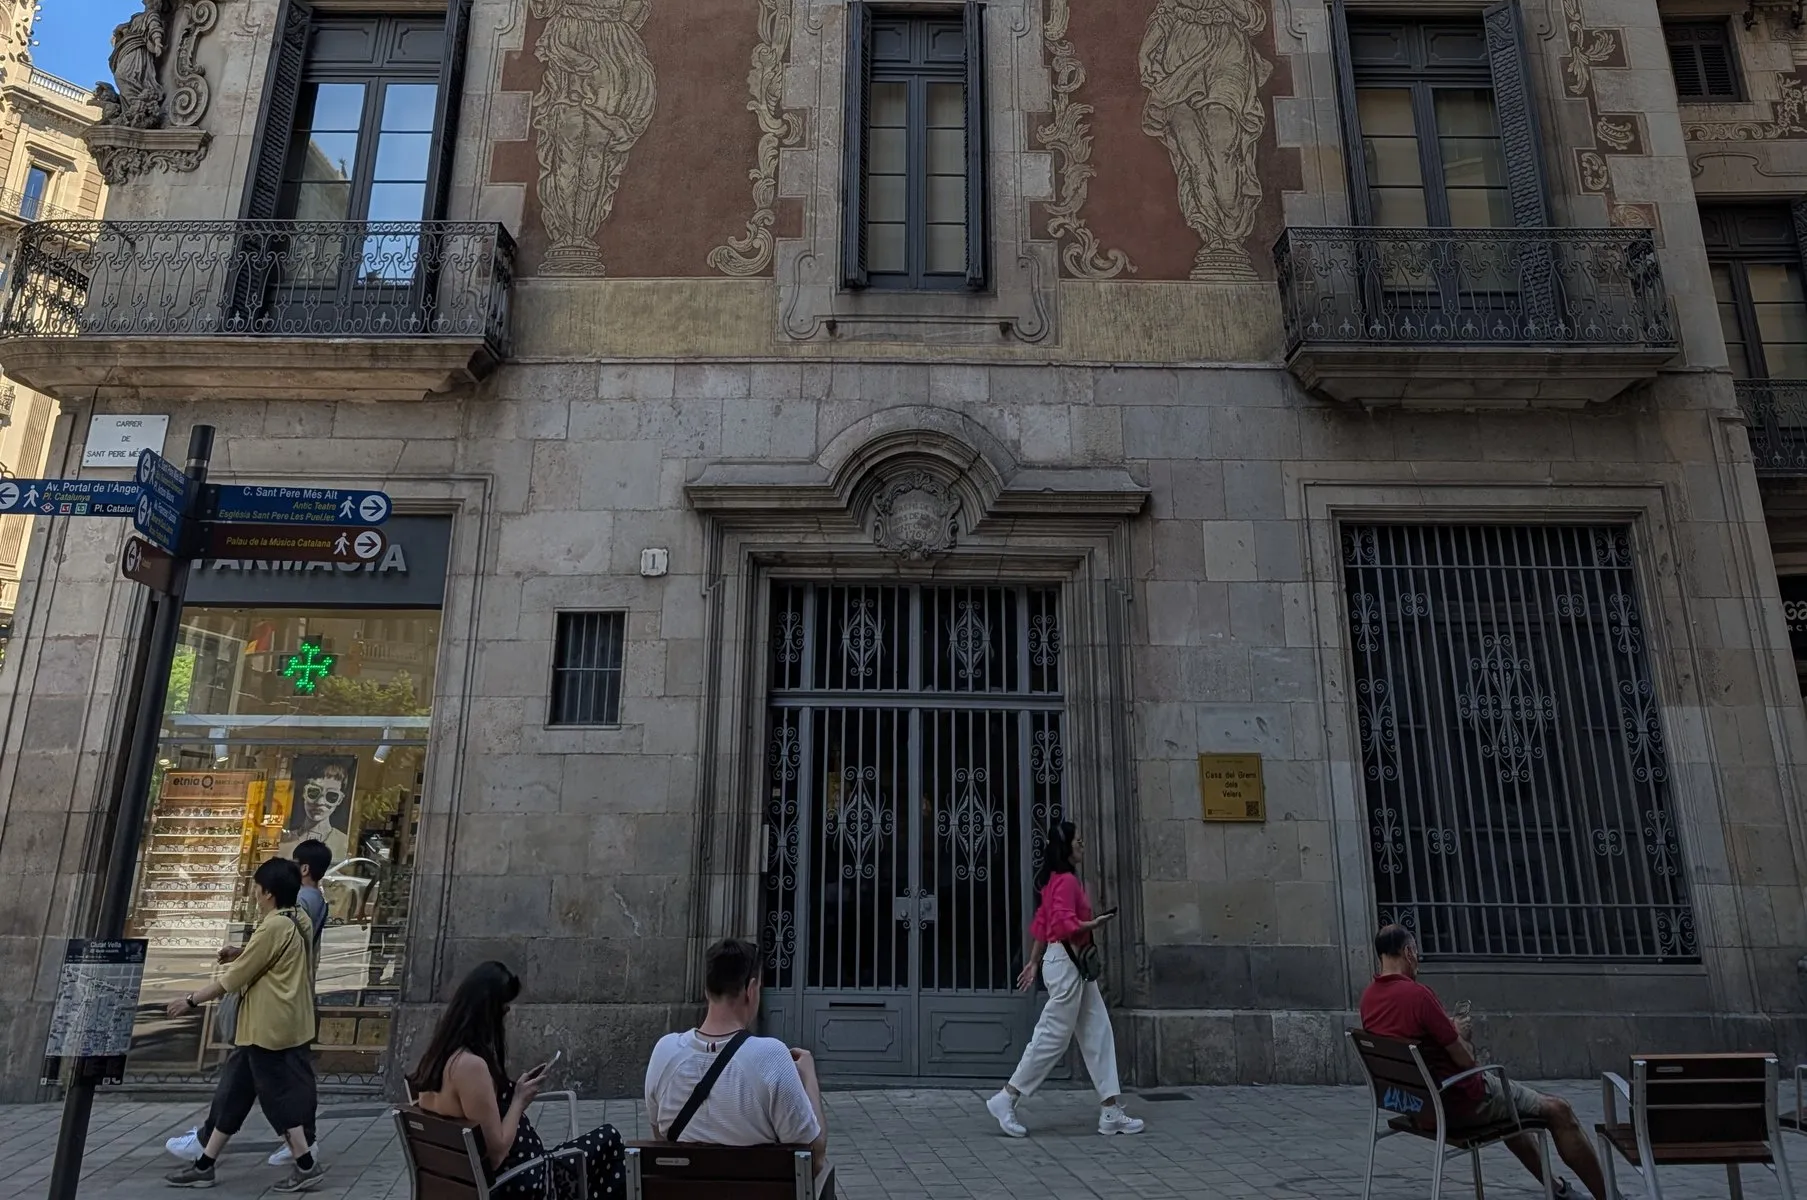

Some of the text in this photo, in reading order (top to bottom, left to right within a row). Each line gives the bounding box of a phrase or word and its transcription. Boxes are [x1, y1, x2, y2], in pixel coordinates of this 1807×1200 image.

[115, 420, 143, 428] CARRER
[121, 435, 131, 443] DE
[86, 450, 106, 458] SANT
[107, 450, 127, 458] PERE
[45, 481, 60, 491] Av.
[62, 482, 92, 492] Portal
[92, 482, 105, 493] de
[42, 492, 91, 503] Pl. Catalunya
[243, 486, 338, 500] C. Sant Pere Més Alt
[93, 503, 104, 513] Pl.
[292, 501, 312, 510] Antic
[218, 509, 251, 520] Església
[252, 510, 270, 520] Sant
[271, 511, 289, 520] Pere
[290, 511, 304, 521] Les
[225, 536, 331, 548] Palau de la Música Catalana
[1205, 770, 1222, 779] Casa
[1225, 770, 1236, 779] del
[173, 775, 200, 786] etnia
